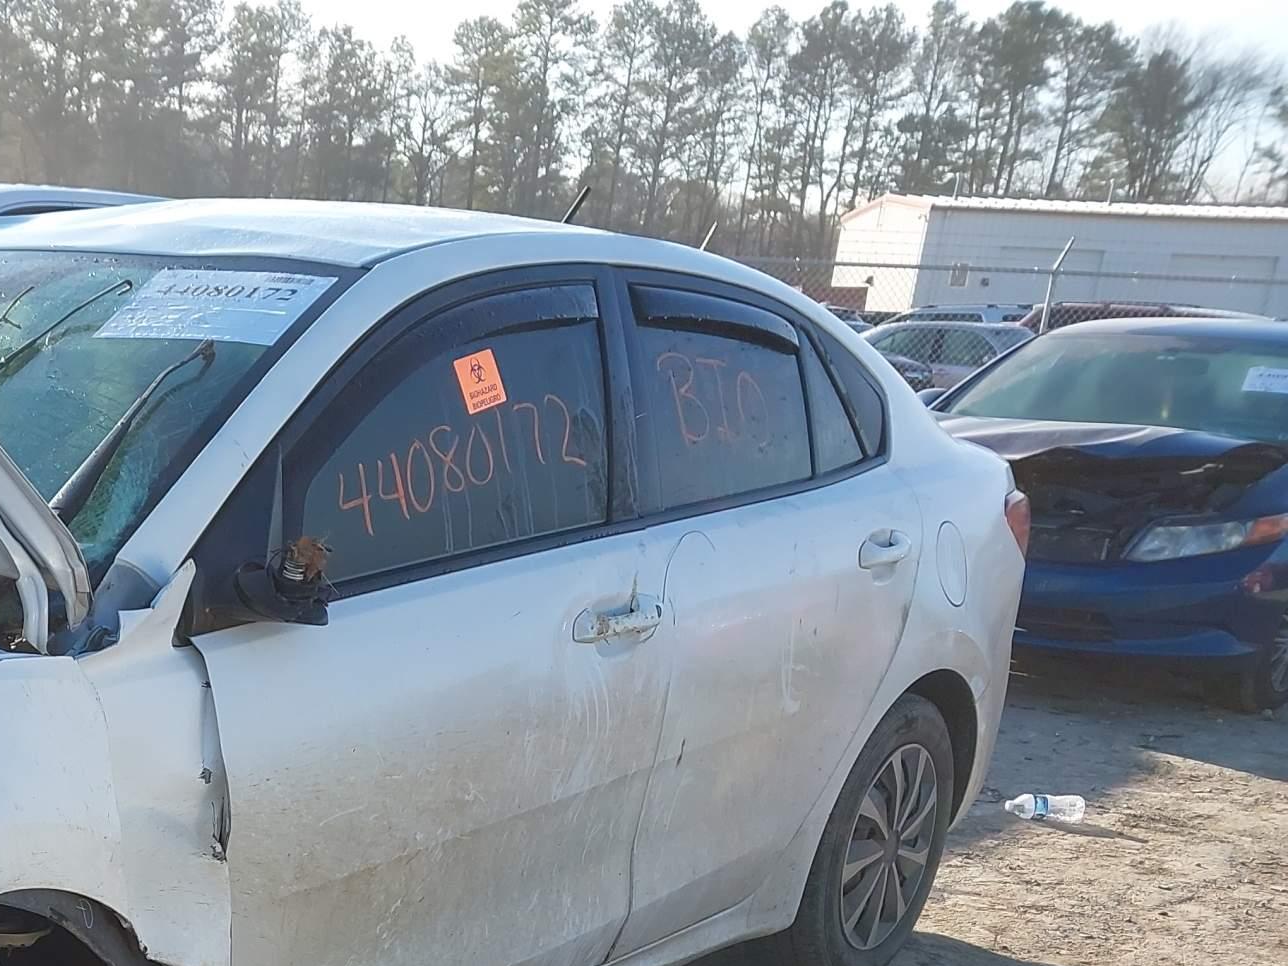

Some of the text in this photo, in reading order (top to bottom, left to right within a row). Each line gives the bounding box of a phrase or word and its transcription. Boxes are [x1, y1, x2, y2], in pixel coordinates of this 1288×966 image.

[157, 282, 299, 302] 44080172
[470, 384, 497, 399] BIOHAZARD
[472, 394, 501, 409] BIOPELIGRO
[336, 394, 587, 536] 44080172
